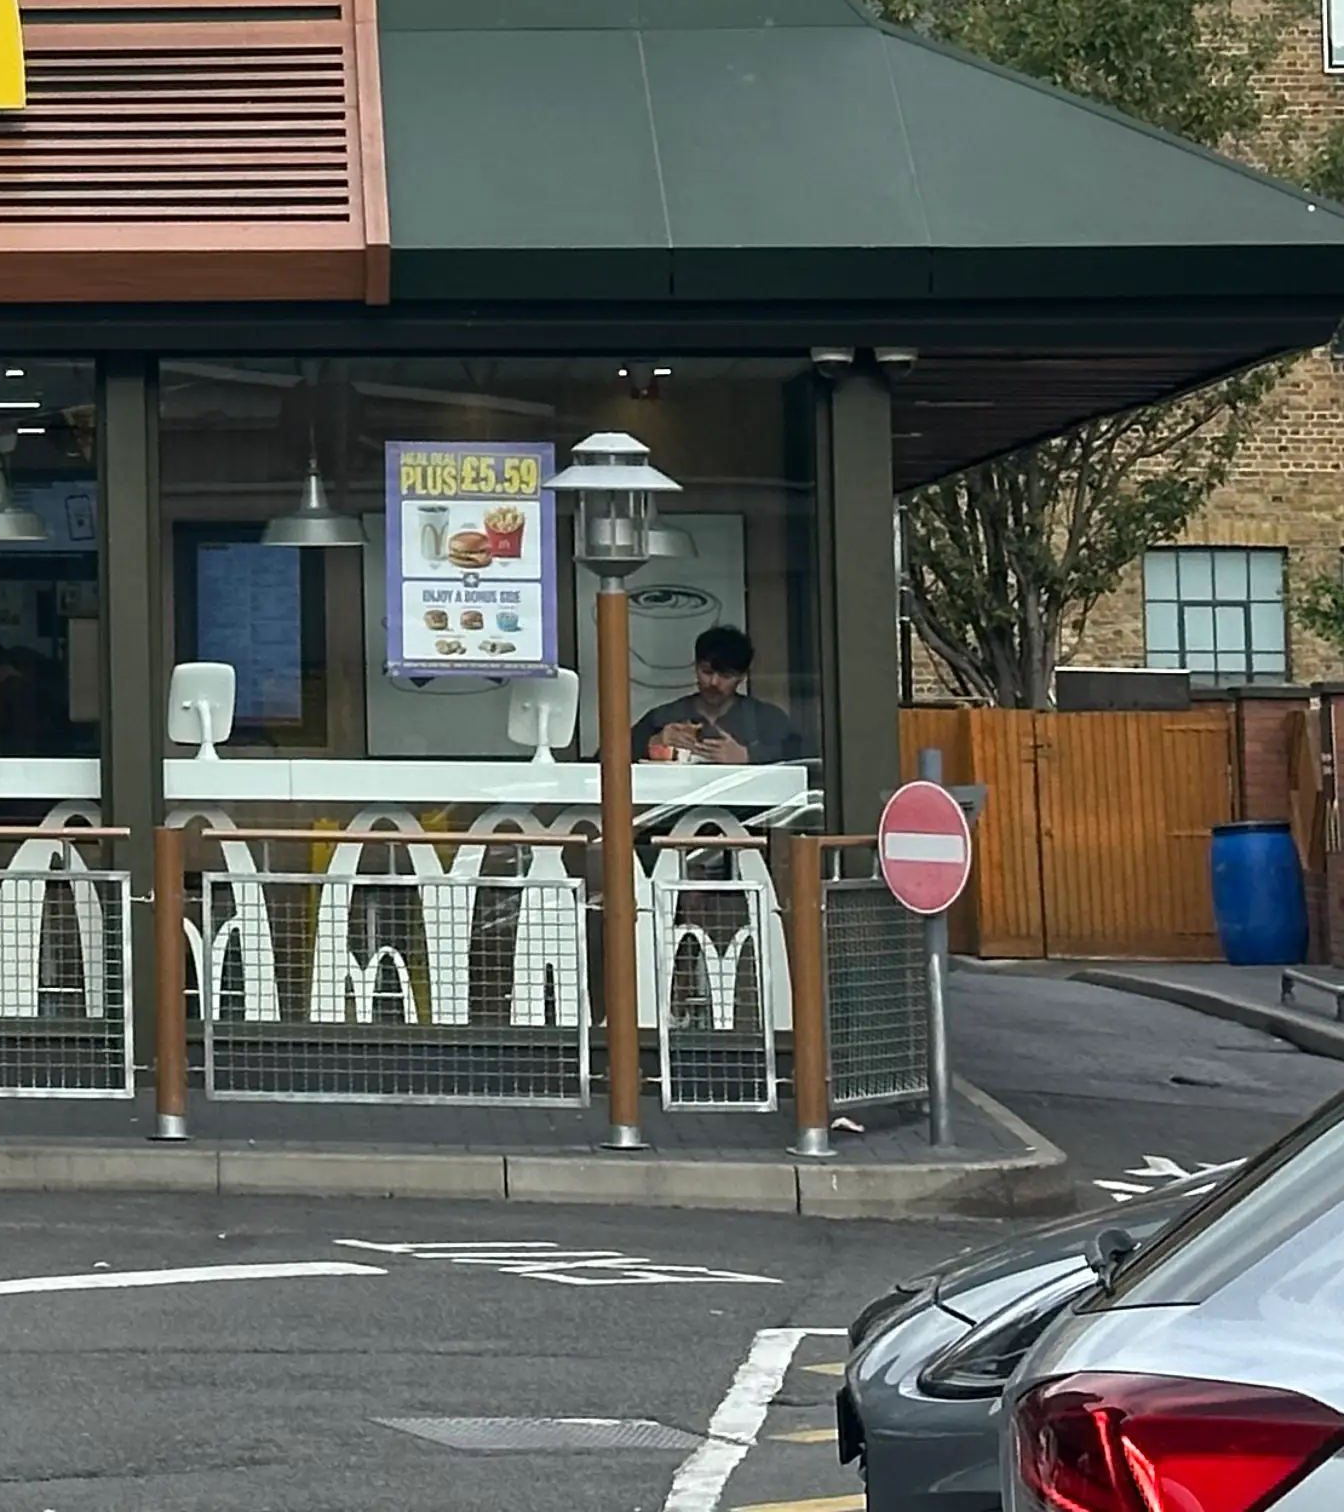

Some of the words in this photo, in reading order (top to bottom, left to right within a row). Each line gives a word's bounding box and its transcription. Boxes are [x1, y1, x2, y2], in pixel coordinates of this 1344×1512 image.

[400, 466, 457, 496] PLUS
[461, 456, 537, 494] £5.59
[422, 590, 454, 603] ENJOY
[454, 590, 463, 603] A
[464, 590, 498, 604] BONUS
